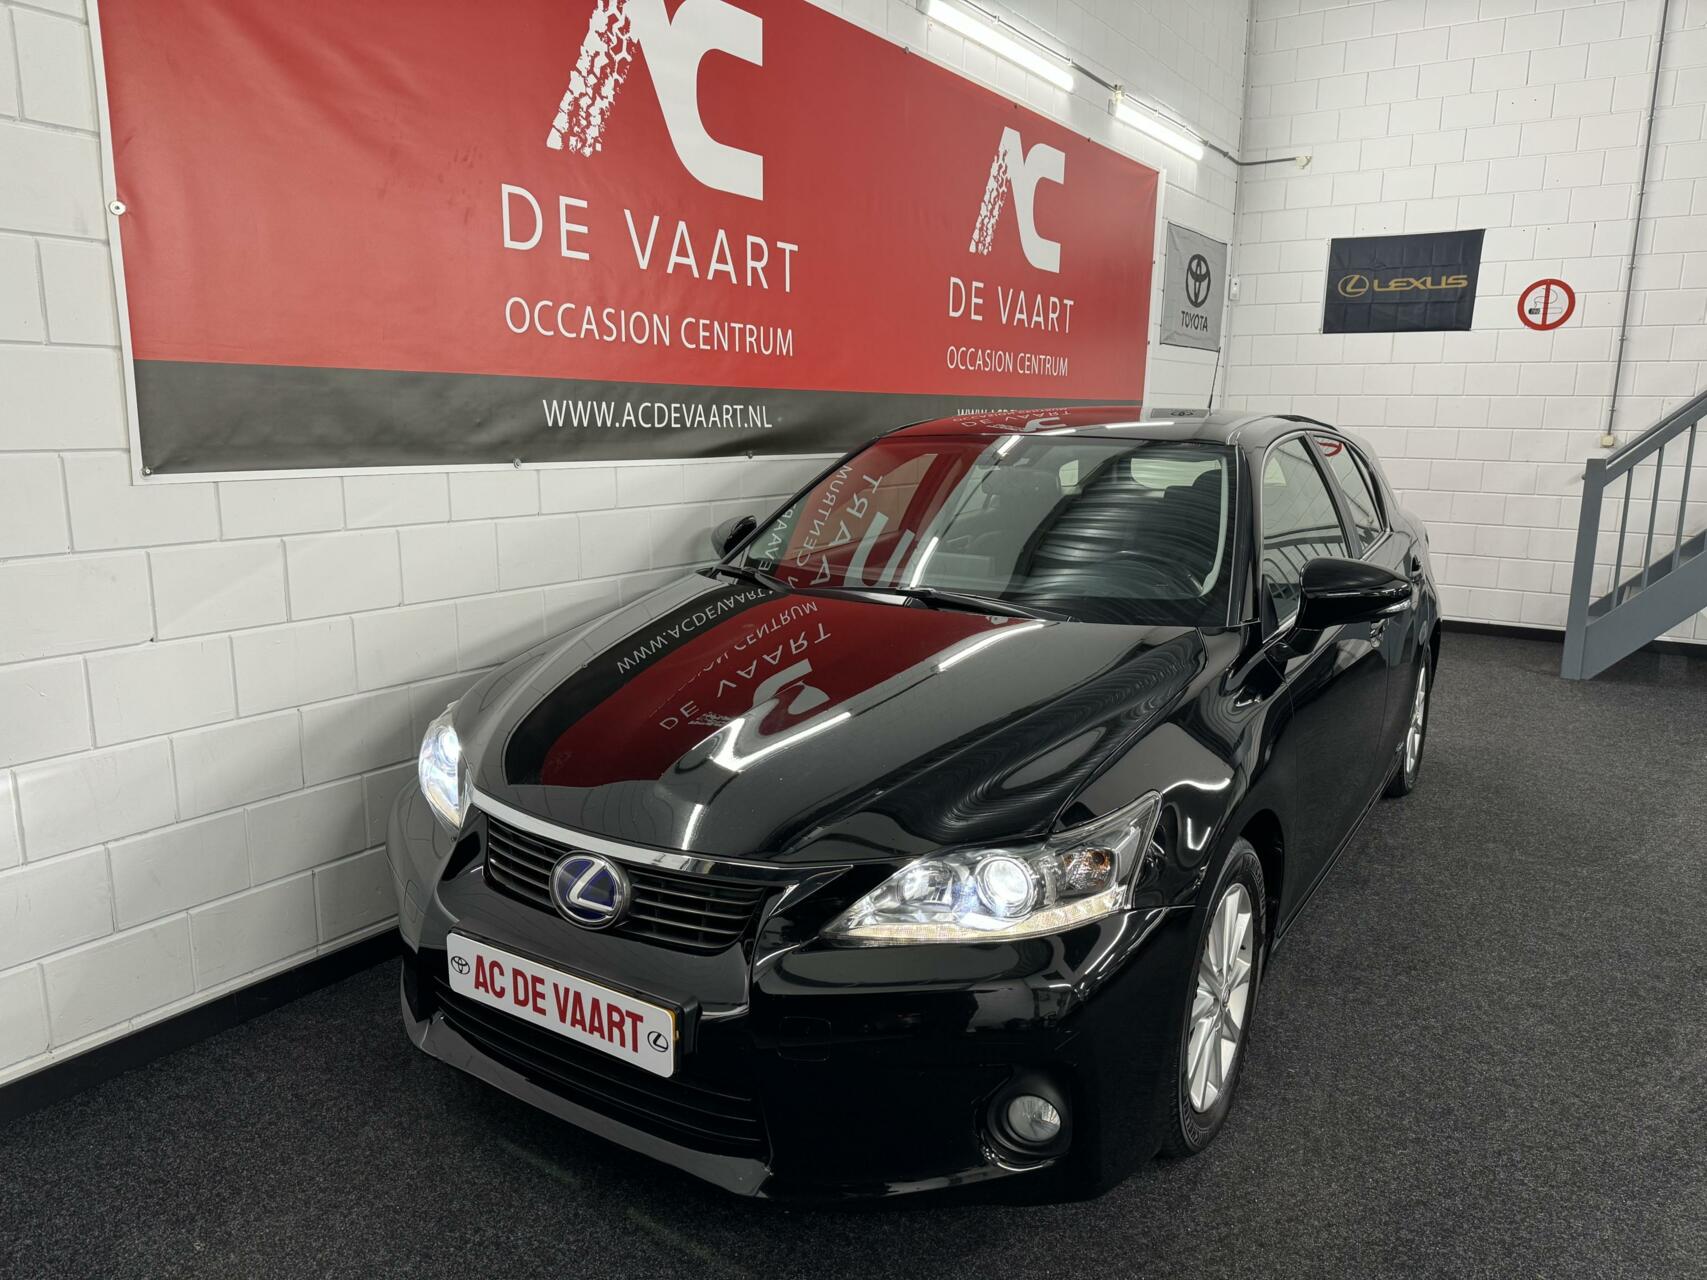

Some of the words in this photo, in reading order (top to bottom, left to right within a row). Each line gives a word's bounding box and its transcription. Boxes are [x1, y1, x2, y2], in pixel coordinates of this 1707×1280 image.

[501, 183, 591, 261] DE
[623, 208, 799, 293] VAART
[948, 276, 985, 321] DE
[998, 286, 1075, 334] VAART
[1372, 274, 1469, 292] LEXUS
[505, 296, 671, 347] OCCASION
[680, 317, 794, 357] CENTRUM
[1181, 310, 1209, 332] TOYOTA
[947, 345, 1013, 373] OCCASION
[1017, 352, 1069, 377] CENTRUM
[542, 399, 773, 429] WWW.ACDEVAART.NL
[474, 954, 506, 999] AC
[512, 967, 547, 1016] DE
[553, 982, 644, 1054] VAART
